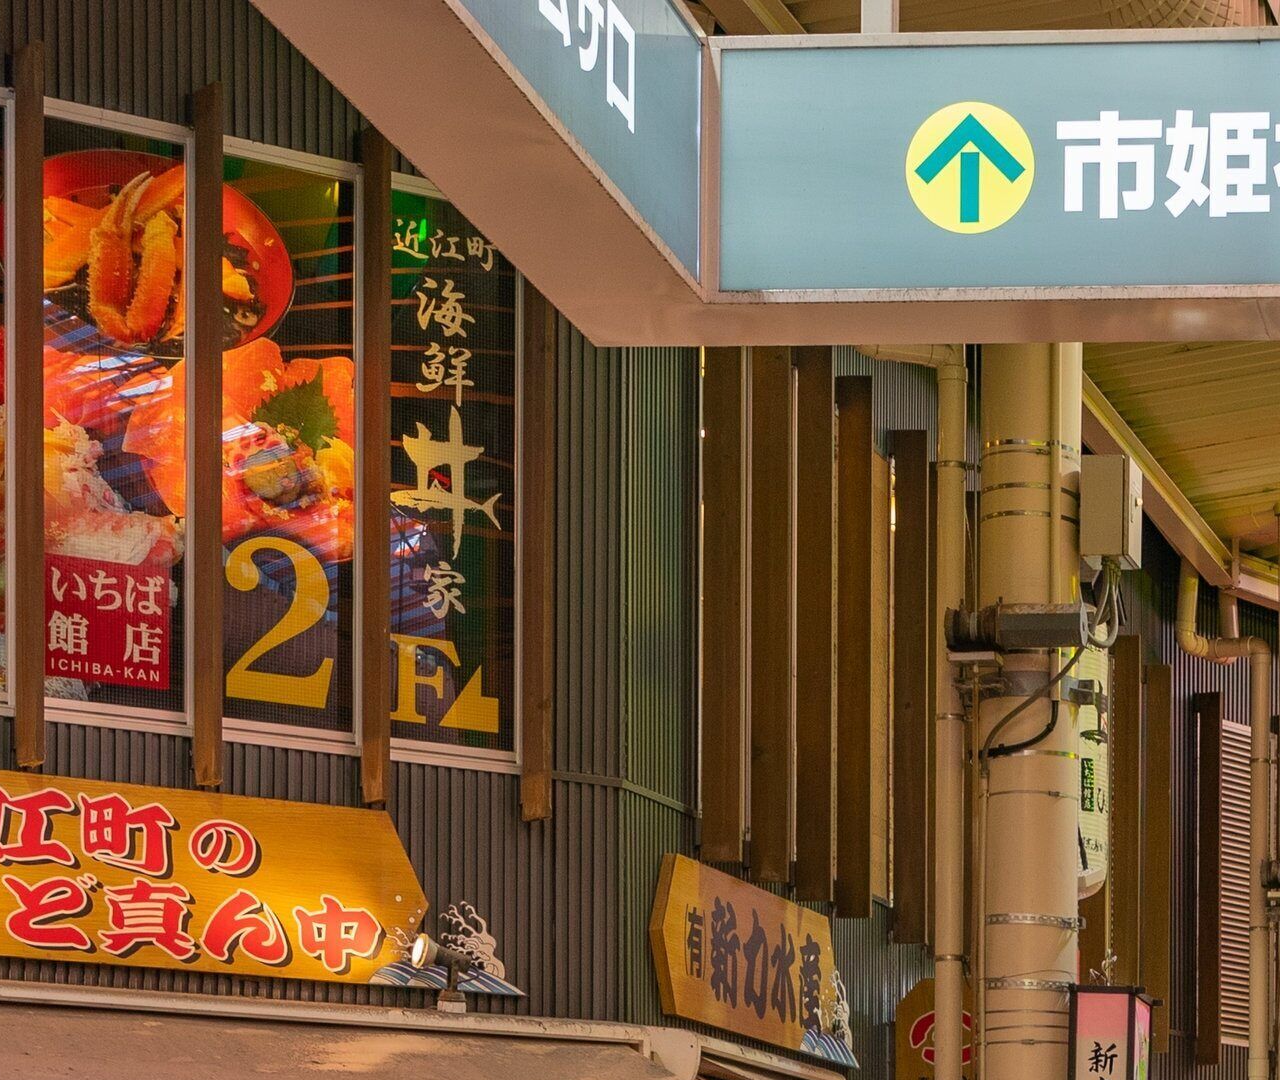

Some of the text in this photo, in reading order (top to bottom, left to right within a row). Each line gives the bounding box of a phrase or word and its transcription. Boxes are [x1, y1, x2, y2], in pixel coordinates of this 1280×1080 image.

[392, 218, 497, 273] 近江町
[50, 566, 164, 616] いちば
[50, 657, 162, 684] ICHIBA-KAN
[1, 870, 386, 977] ど真ん中
